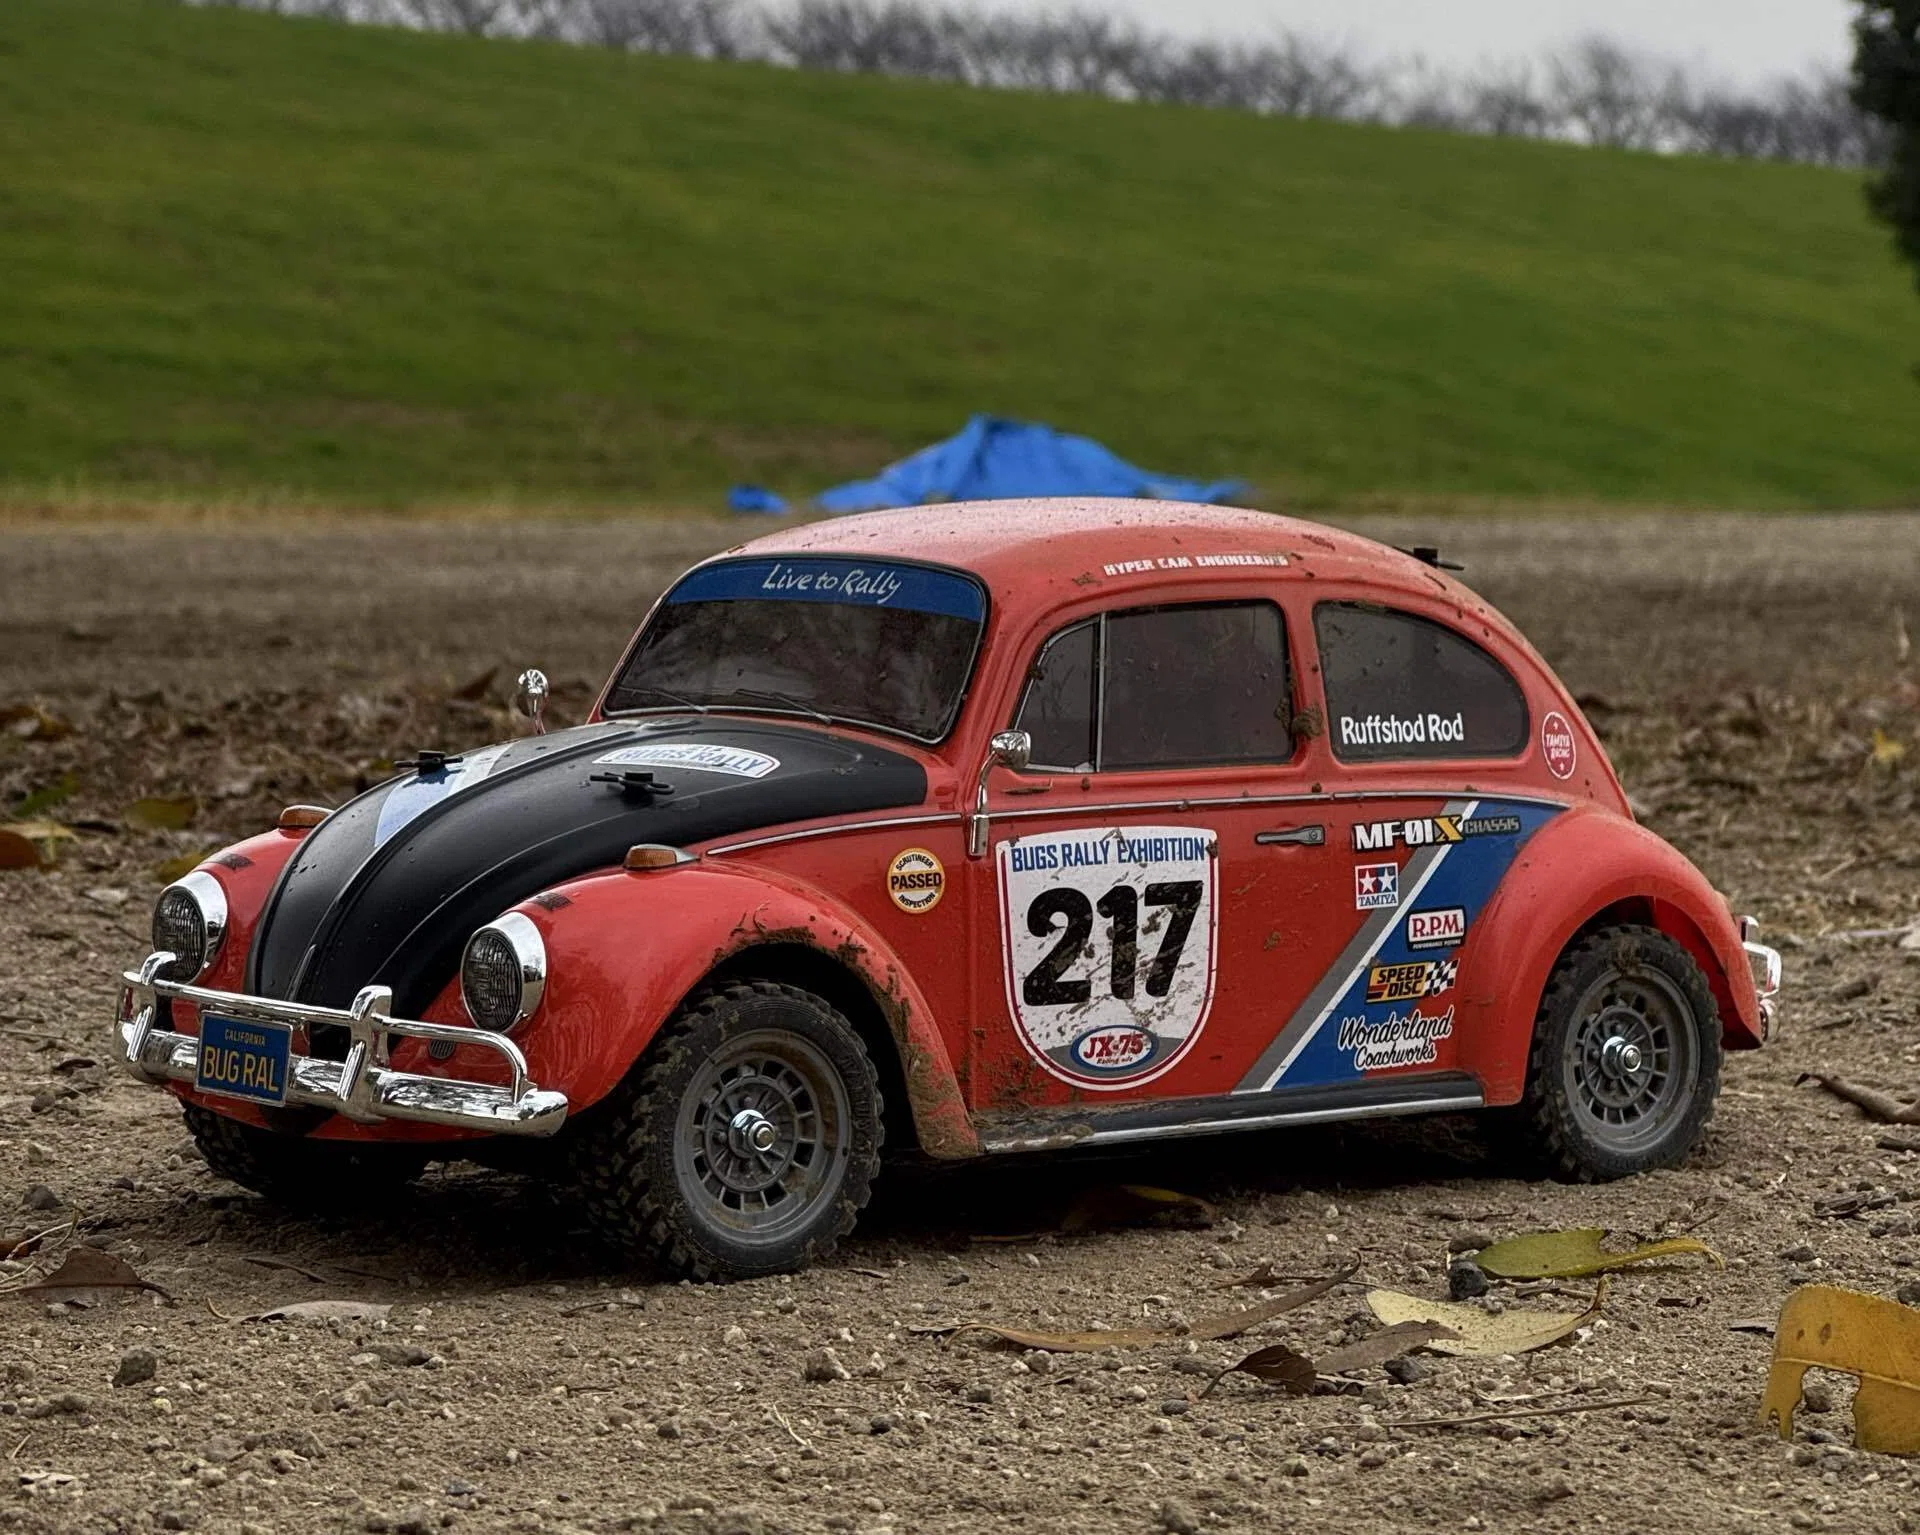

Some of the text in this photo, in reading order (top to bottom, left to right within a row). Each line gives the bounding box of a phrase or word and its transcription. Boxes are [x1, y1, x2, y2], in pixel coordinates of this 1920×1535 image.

[1103, 559, 1153, 576] HYPER
[1157, 555, 1193, 569] CAM
[762, 563, 902, 604] Live to Rally
[1340, 712, 1464, 745] Ruffshod Rod
[690, 750, 769, 771] RALLY
[1464, 817, 1520, 833] CHASSIS
[1011, 837, 1205, 872] BUGS RALLY EXHIBITION
[891, 872, 942, 890] PASSED
[898, 891, 936, 908] INSPECTION
[1357, 893, 1398, 907] TAMIYA
[1411, 914, 1464, 938] R.P.M.
[1023, 880, 1204, 1006] 217
[1377, 964, 1426, 984] SPEED
[1387, 980, 1423, 998] DISC
[224, 1028, 266, 1047] CALIFORNIA
[1338, 1005, 1454, 1051] Wonderland
[1354, 1041, 1437, 1070] Coachworks
[203, 1045, 279, 1092] BUG RAL
